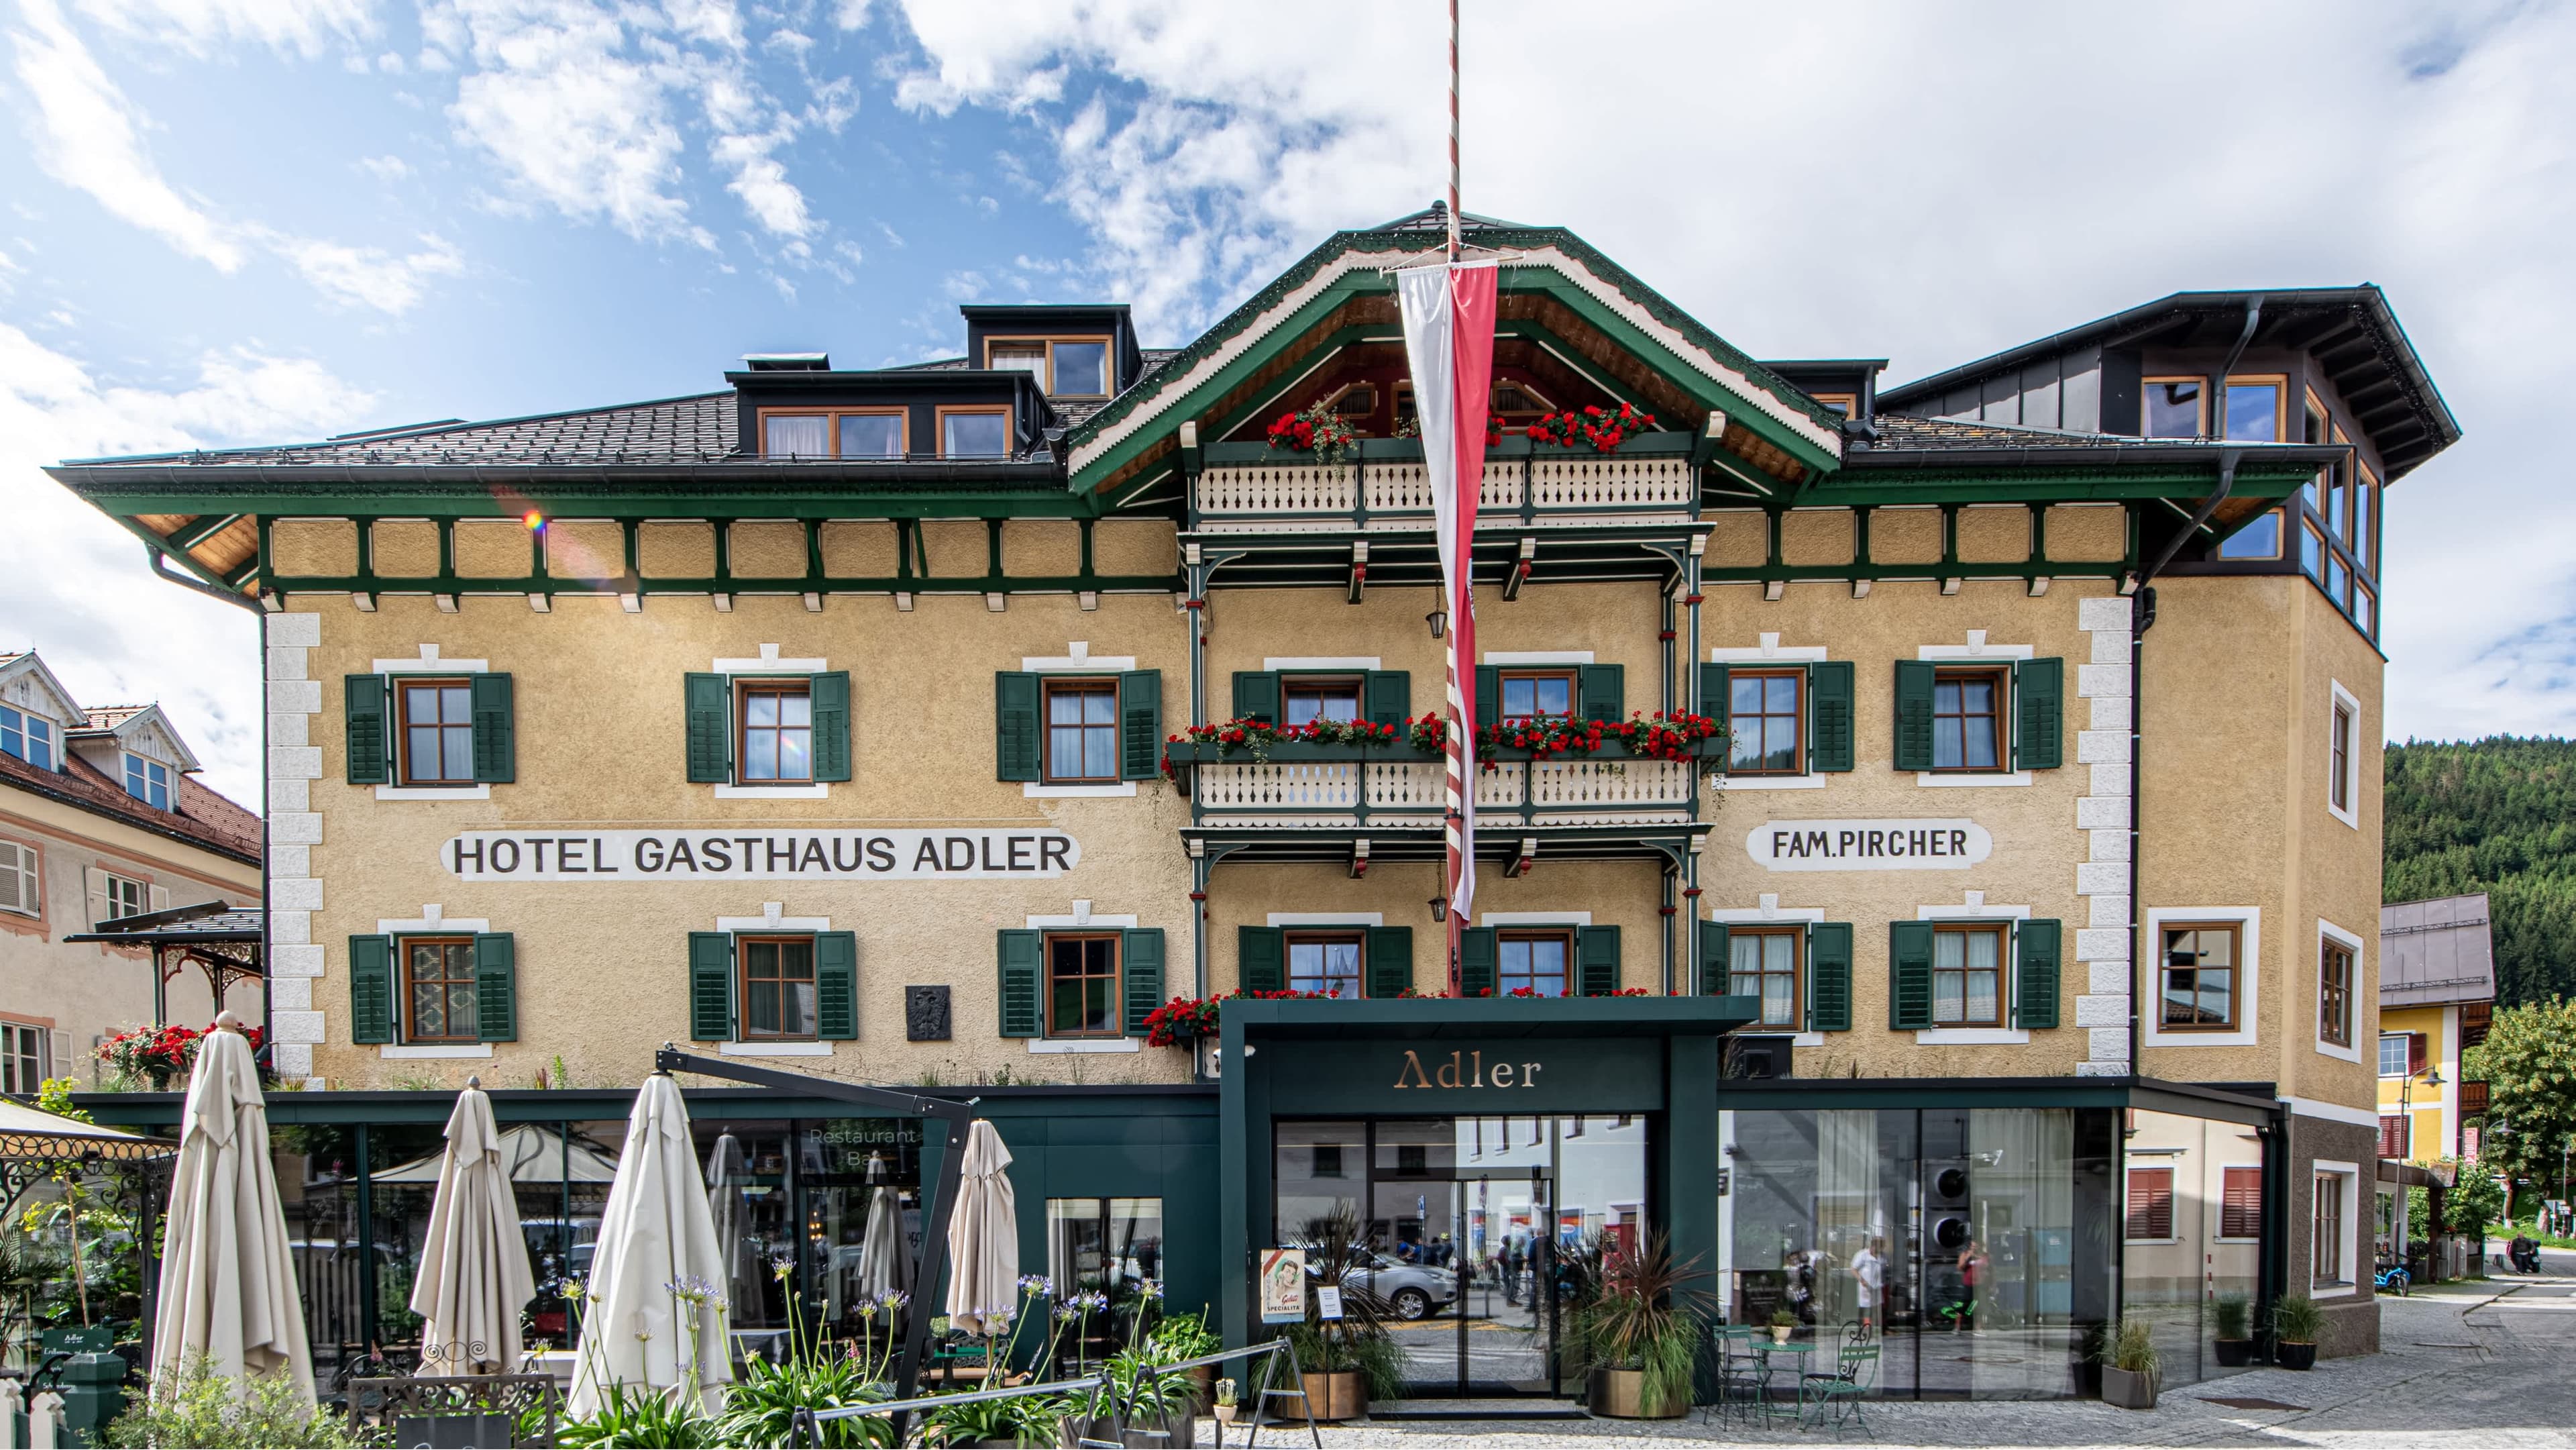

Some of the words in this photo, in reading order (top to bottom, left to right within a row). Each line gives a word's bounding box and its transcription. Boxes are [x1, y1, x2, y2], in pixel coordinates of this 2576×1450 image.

[454, 837, 619, 873] HOTEL
[635, 837, 896, 872] GASTHAUS
[912, 836, 1071, 872] ADLER
[1772, 829, 1967, 858] FAM.PIRCHER
[1393, 1049, 1542, 1089] Adler
[810, 1129, 916, 1144] Restaurant
[847, 1151, 874, 1166] Ba
[64, 1333, 85, 1341] Adler
